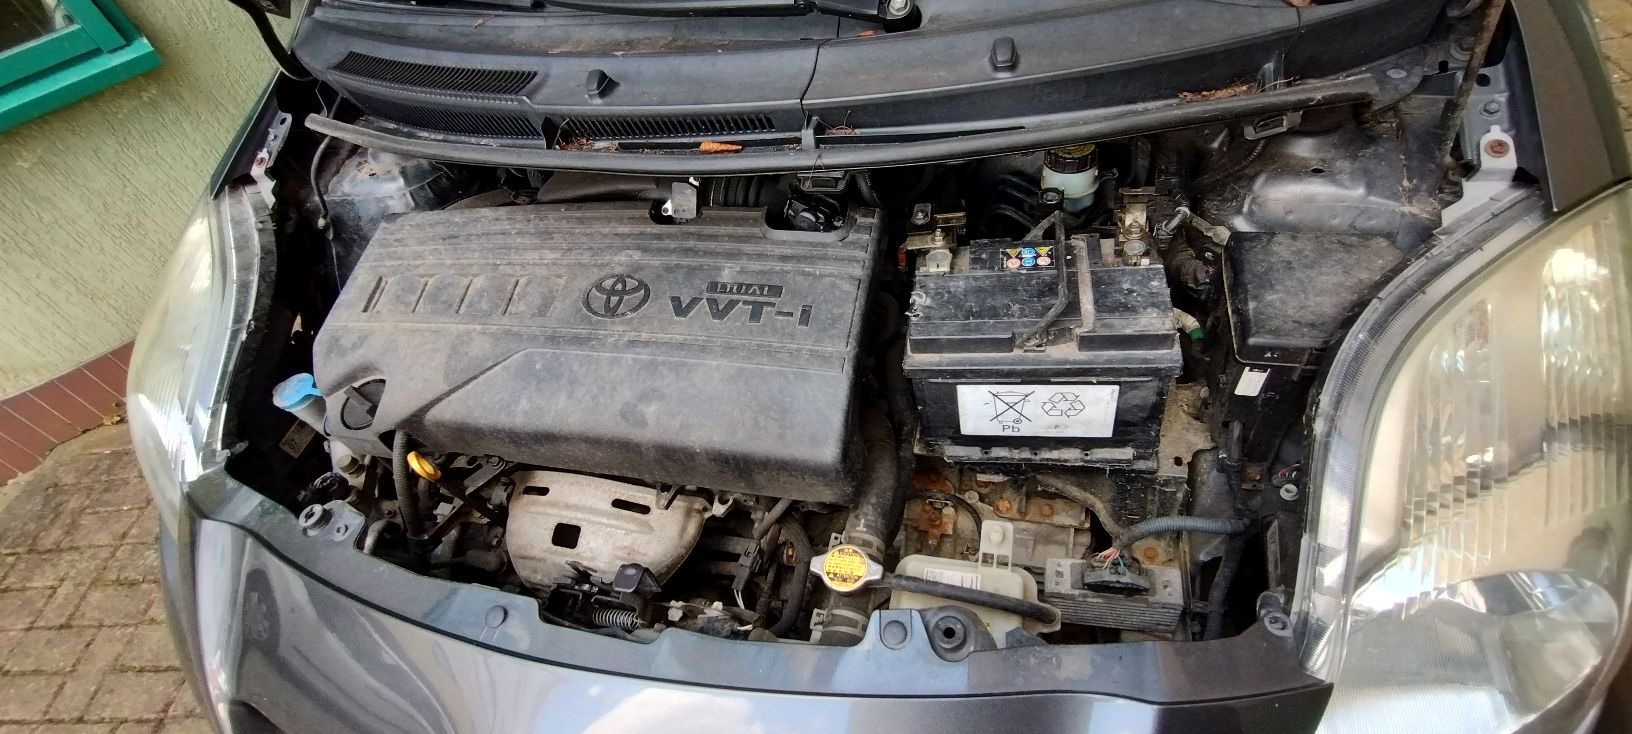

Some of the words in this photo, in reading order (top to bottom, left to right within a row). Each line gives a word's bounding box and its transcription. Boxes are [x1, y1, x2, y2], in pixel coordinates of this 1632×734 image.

[716, 282, 769, 295] DUAL
[670, 295, 813, 327] VVT-i
[1002, 424, 1021, 432] Pb
